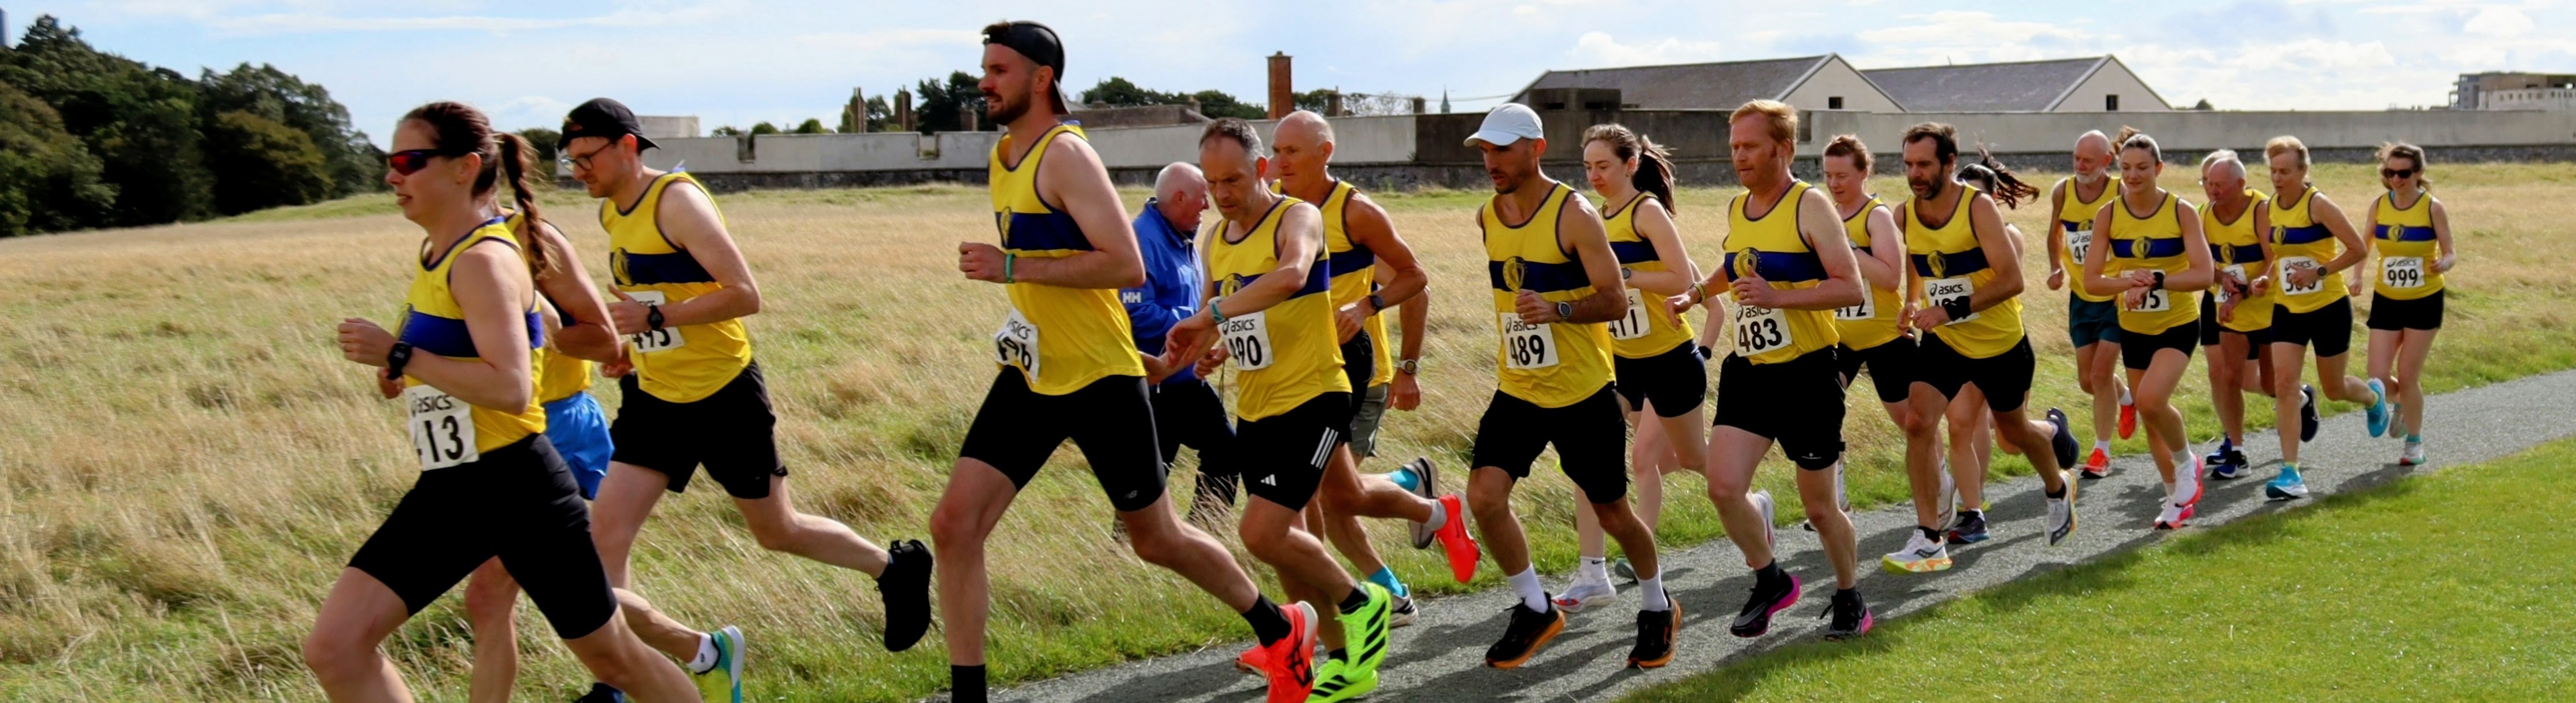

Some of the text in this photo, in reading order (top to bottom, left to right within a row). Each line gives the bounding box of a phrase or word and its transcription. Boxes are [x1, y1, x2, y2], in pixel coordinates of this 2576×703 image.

[2387, 269, 2418, 287] 999
[1123, 292, 1141, 304] HH
[1938, 284, 1964, 295] asics
[1231, 319, 1254, 332] asics
[1739, 318, 1782, 352] 483
[1510, 335, 1545, 366] 489
[416, 415, 464, 462] 13
